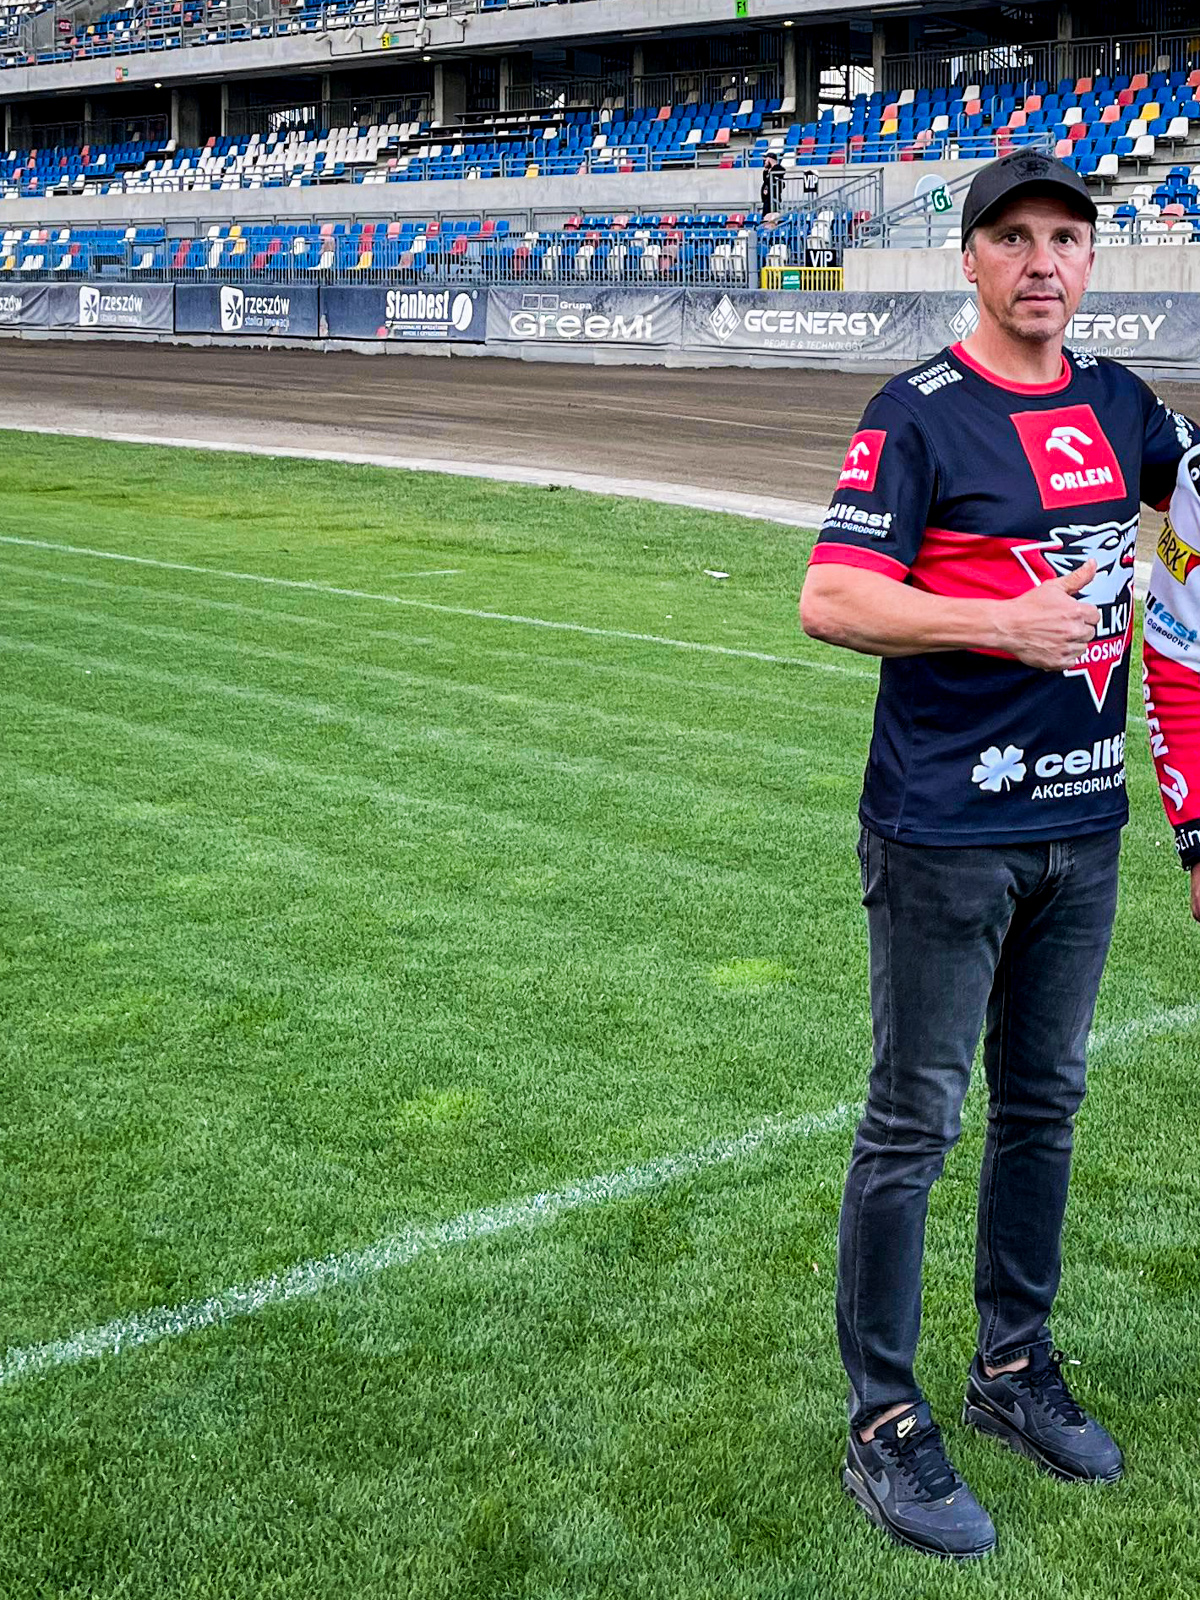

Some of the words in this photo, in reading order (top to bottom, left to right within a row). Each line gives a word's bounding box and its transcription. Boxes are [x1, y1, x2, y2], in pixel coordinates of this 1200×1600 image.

[737, 1, 747, 13] F1
[803, 174, 818, 189] VIP
[934, 184, 952, 210] G1
[809, 250, 833, 268] VIP
[100, 294, 143, 312] rzeszów
[245, 295, 290, 315] rzeszów
[386, 290, 449, 319] Stanbest
[560, 301, 592, 312] Grupa
[744, 309, 891, 336] GCENERGY
[806, 341, 864, 351] TECHNOLOGY
[1050, 465, 1113, 491] ORLEN
[1031, 776, 1113, 800] AKCESORIA
